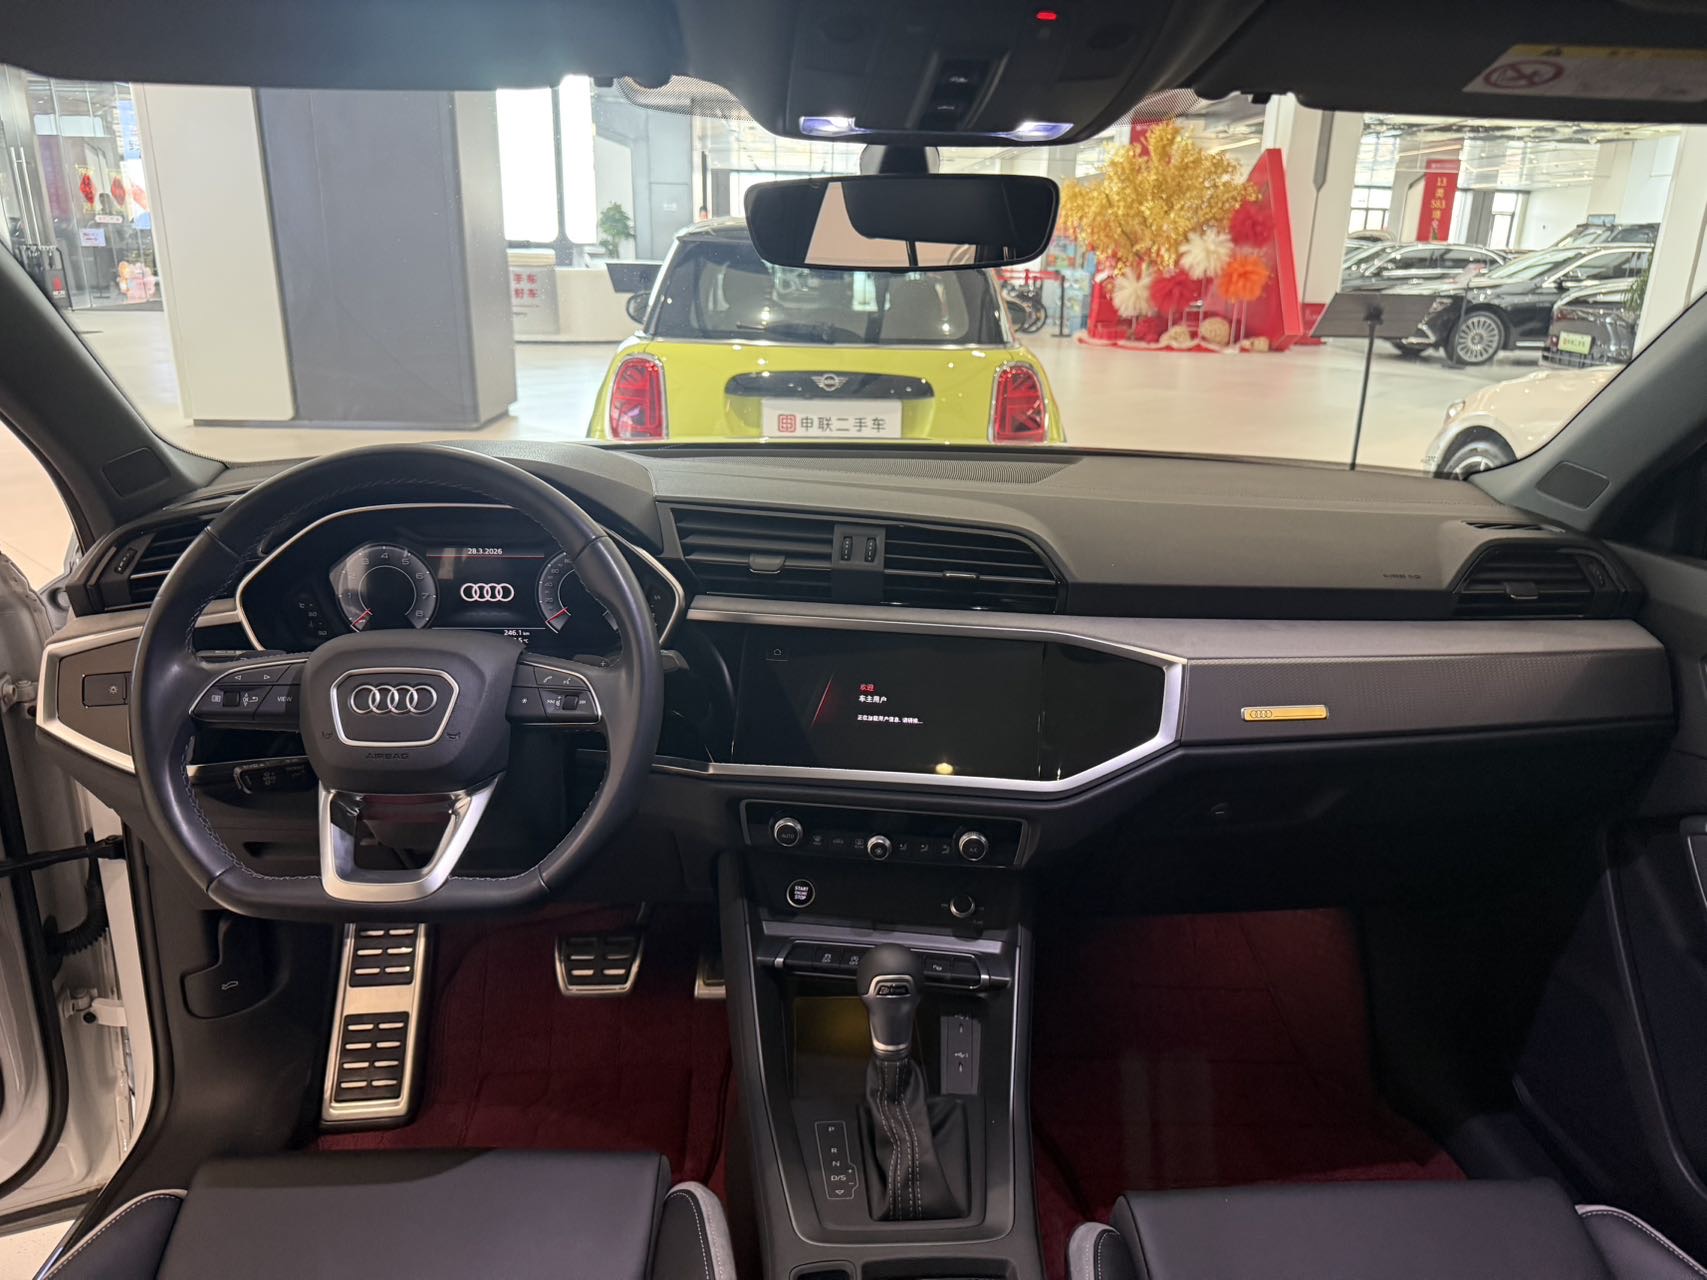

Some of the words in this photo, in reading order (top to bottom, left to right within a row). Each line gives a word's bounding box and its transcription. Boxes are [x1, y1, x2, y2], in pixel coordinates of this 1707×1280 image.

[800, 416, 886, 432] 申联二手车
[859, 695, 887, 703] 车主用户
[365, 752, 410, 760] AIRBAG
